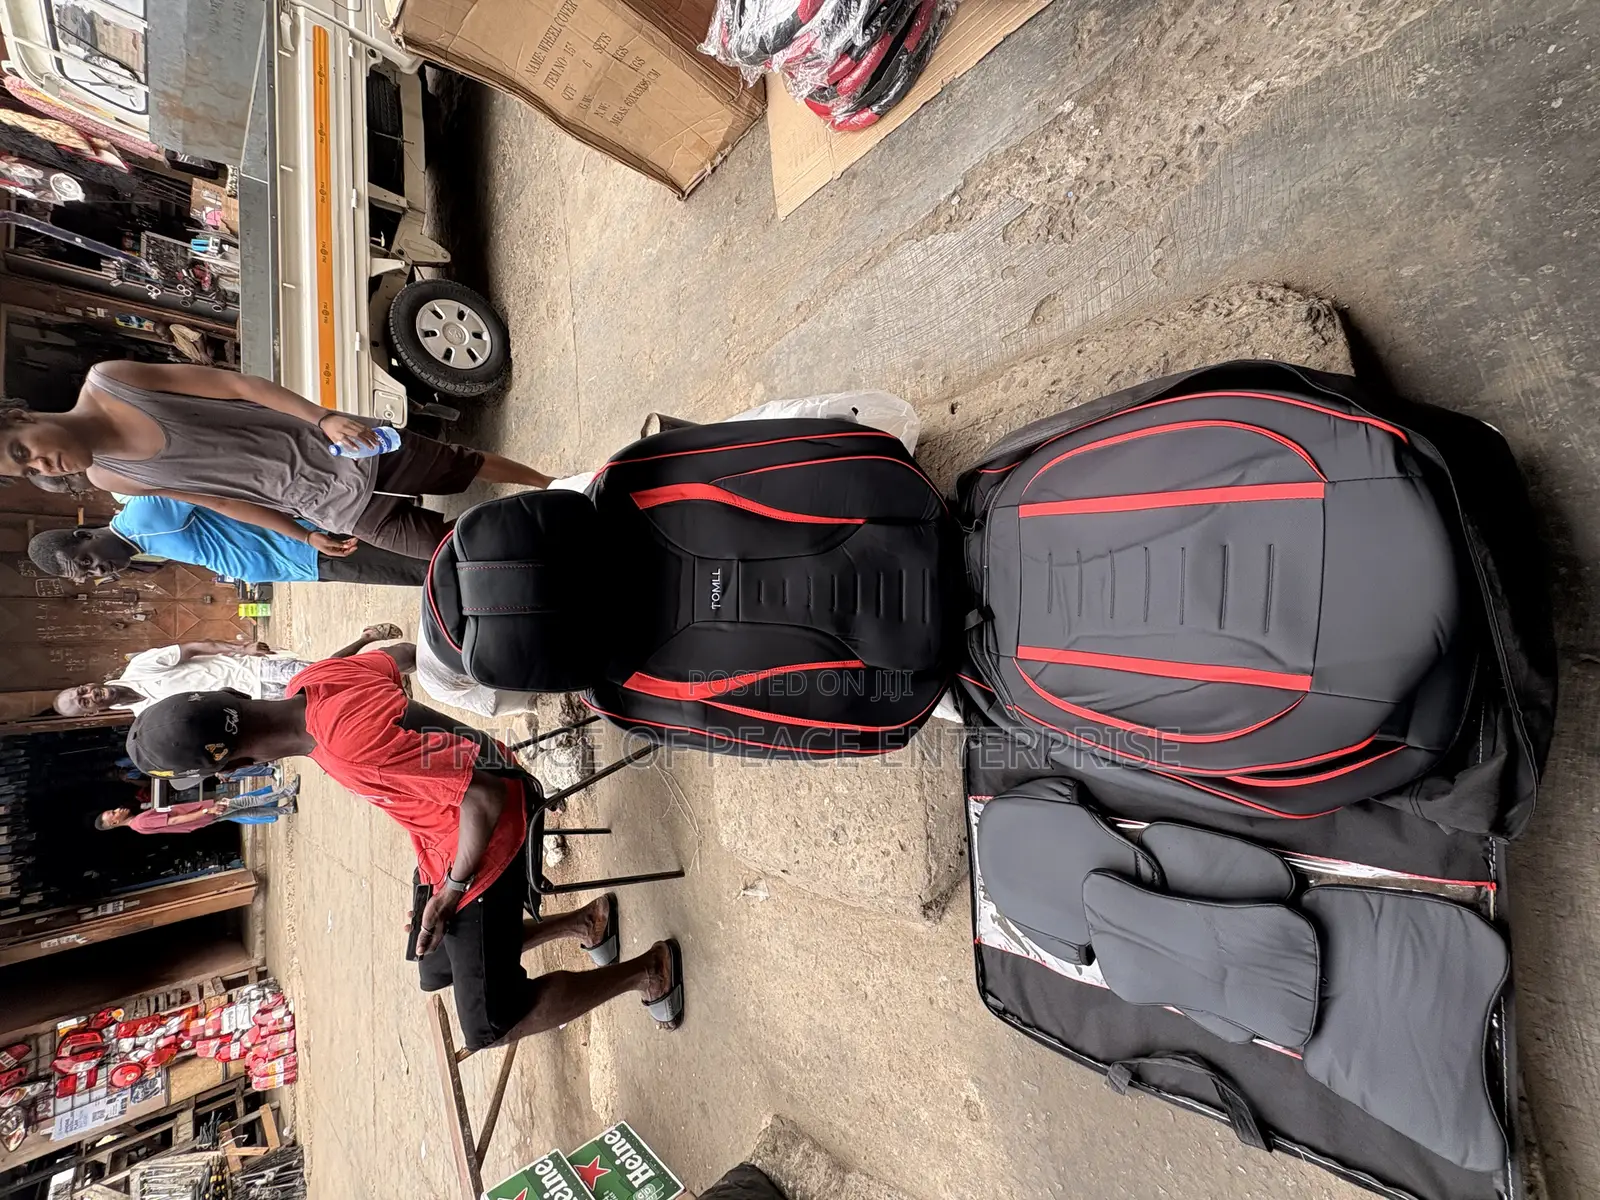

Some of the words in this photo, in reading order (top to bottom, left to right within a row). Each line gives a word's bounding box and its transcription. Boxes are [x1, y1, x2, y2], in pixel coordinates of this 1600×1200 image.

[538, 25, 562, 53] WHEEL
[554, 0, 578, 27] COVER
[582, 59, 592, 69] 6
[593, 32, 612, 54] SETS
[612, 45, 629, 62] KGS
[629, 56, 646, 73] KGS
[543, 66, 561, 90] ITEM
[711, 568, 721, 610] TOMLL
[602, 1128, 656, 1188] Heine
[535, 1158, 579, 1200] eine
